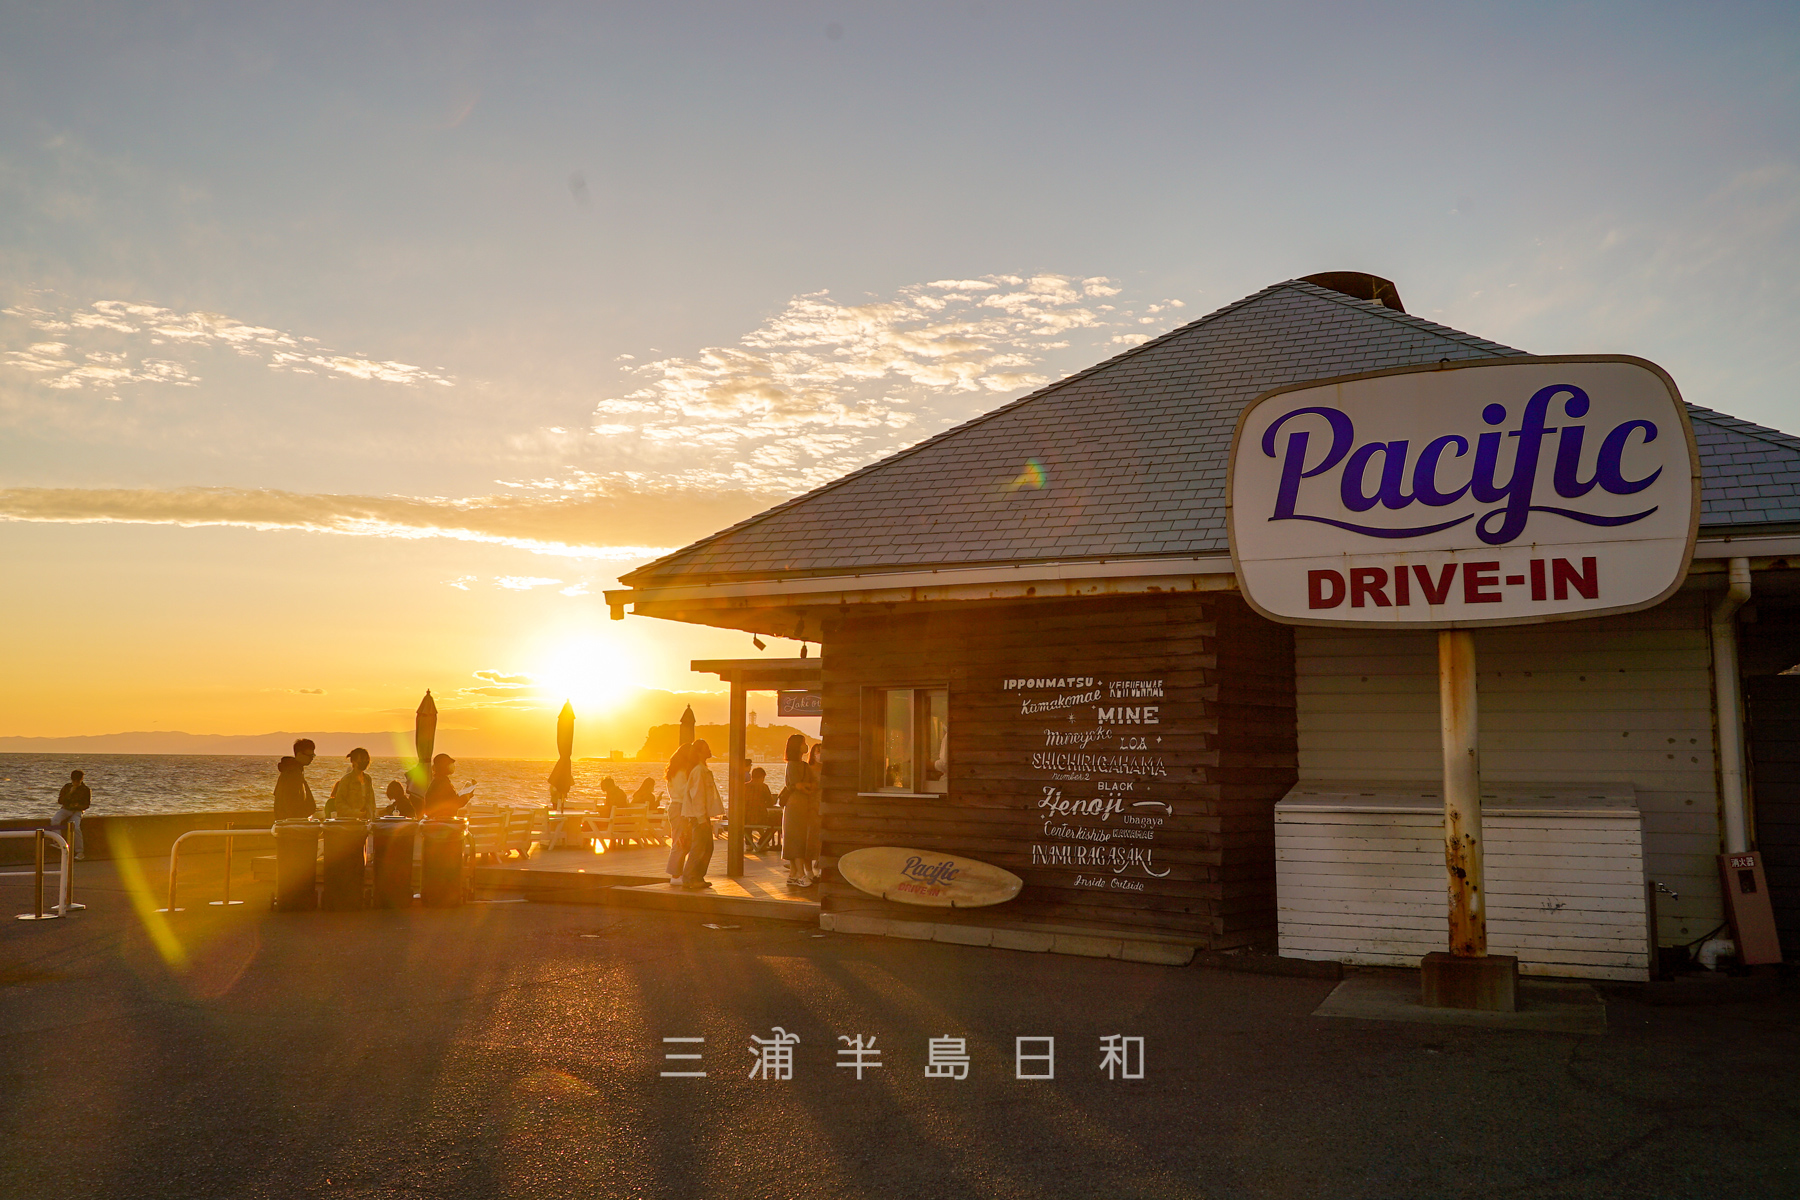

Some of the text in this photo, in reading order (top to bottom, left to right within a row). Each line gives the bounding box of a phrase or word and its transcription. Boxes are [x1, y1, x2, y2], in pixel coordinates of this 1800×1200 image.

[1261, 383, 1664, 545] Pacific
[1307, 556, 1599, 610] DRIVE-IN
[1003, 677, 1094, 690] IPPONMATSU
[784, 696, 810, 713] Take
[1021, 689, 1102, 715] Kamakomae
[1098, 706, 1160, 725] MINE
[1043, 726, 1113, 749] Mineyoko
[1119, 737, 1147, 750] LOA
[1031, 752, 1168, 776] SHICHIRIGAHAMA
[1097, 781, 1134, 791] BLACK
[1123, 815, 1164, 829] Ubagaya
[1112, 828, 1154, 840] KAWAMAE
[1730, 856, 1755, 868] 消火器
[901, 856, 960, 886] Pacific
[898, 882, 941, 897] DRIVE-IN
[1074, 874, 1144, 892] Inside Outside
